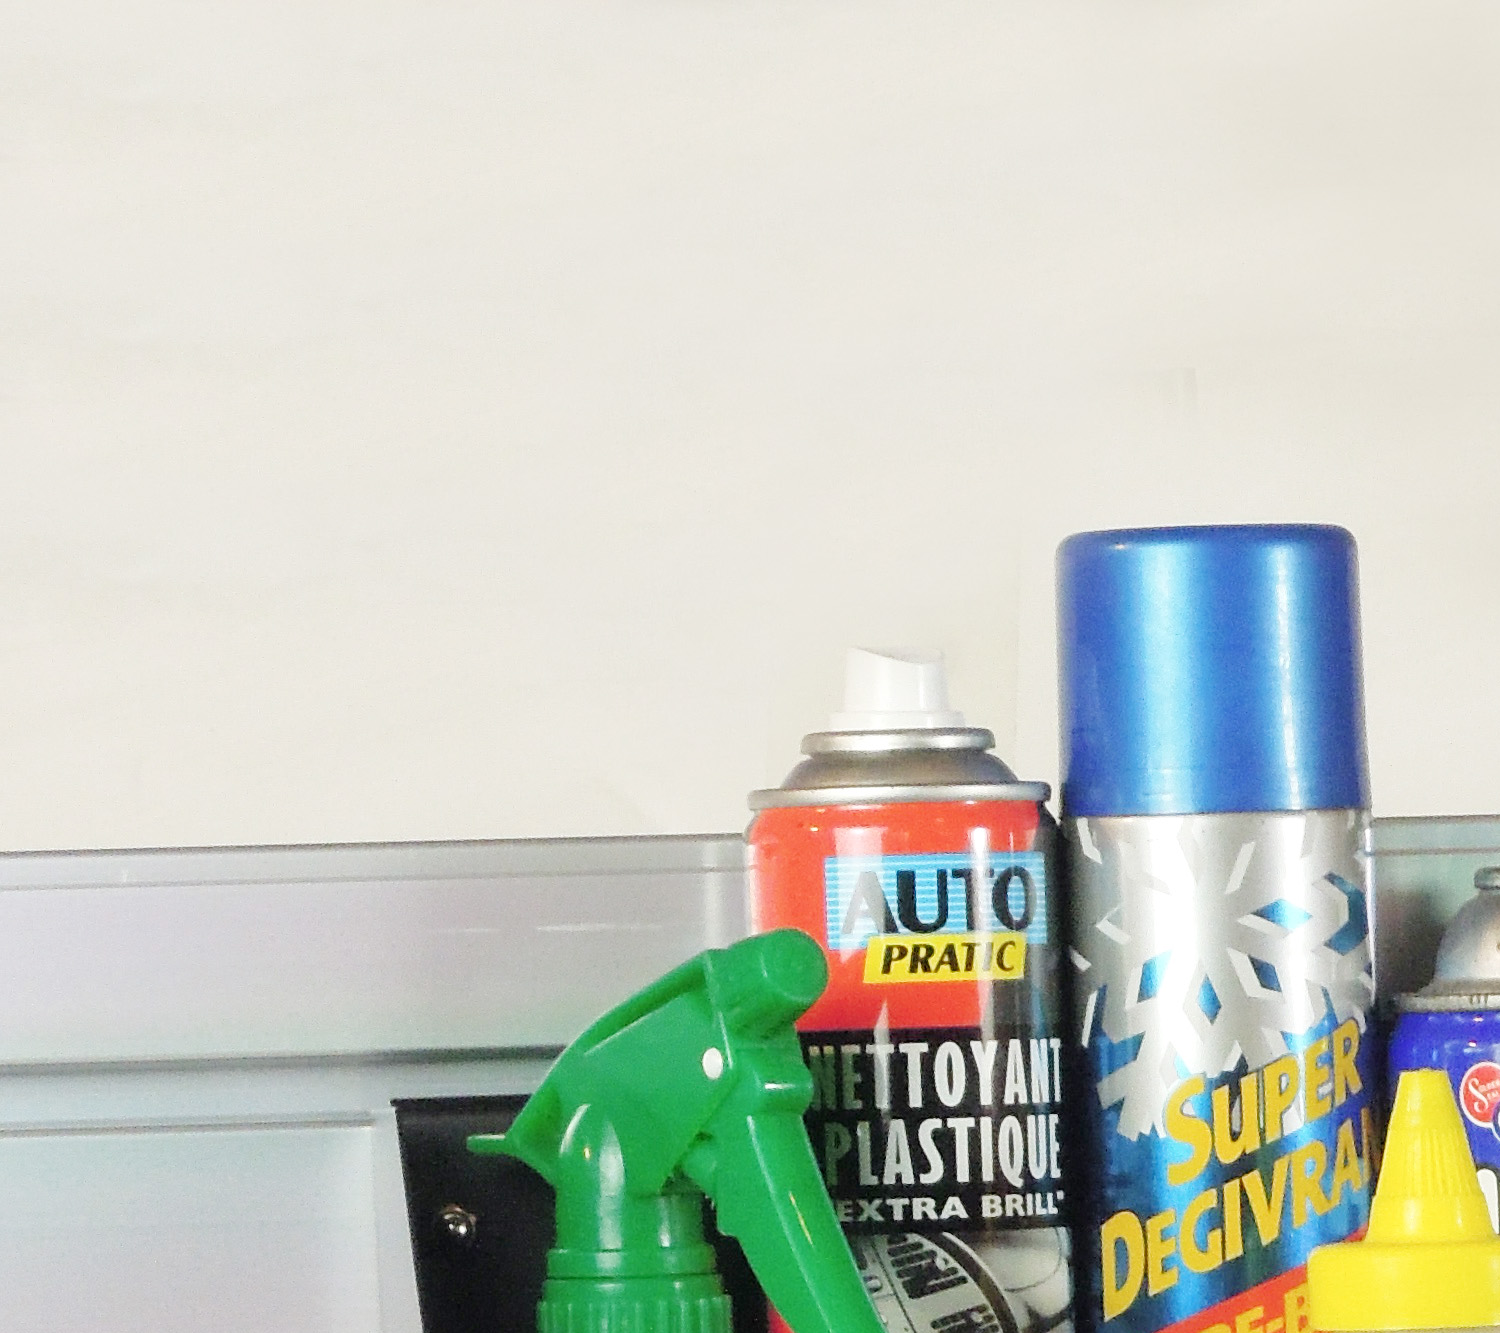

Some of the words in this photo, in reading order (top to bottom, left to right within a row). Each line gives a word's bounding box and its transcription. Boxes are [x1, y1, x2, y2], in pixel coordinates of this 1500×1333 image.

[841, 866, 1036, 933] AUTO
[881, 940, 1015, 975] PRATIC
[808, 1038, 1062, 1108] NETTOYANT
[1164, 1018, 1364, 1187] SUPER
[825, 1113, 1062, 1188] PLASTIQUE
[841, 1194, 969, 1223] EXTRA
